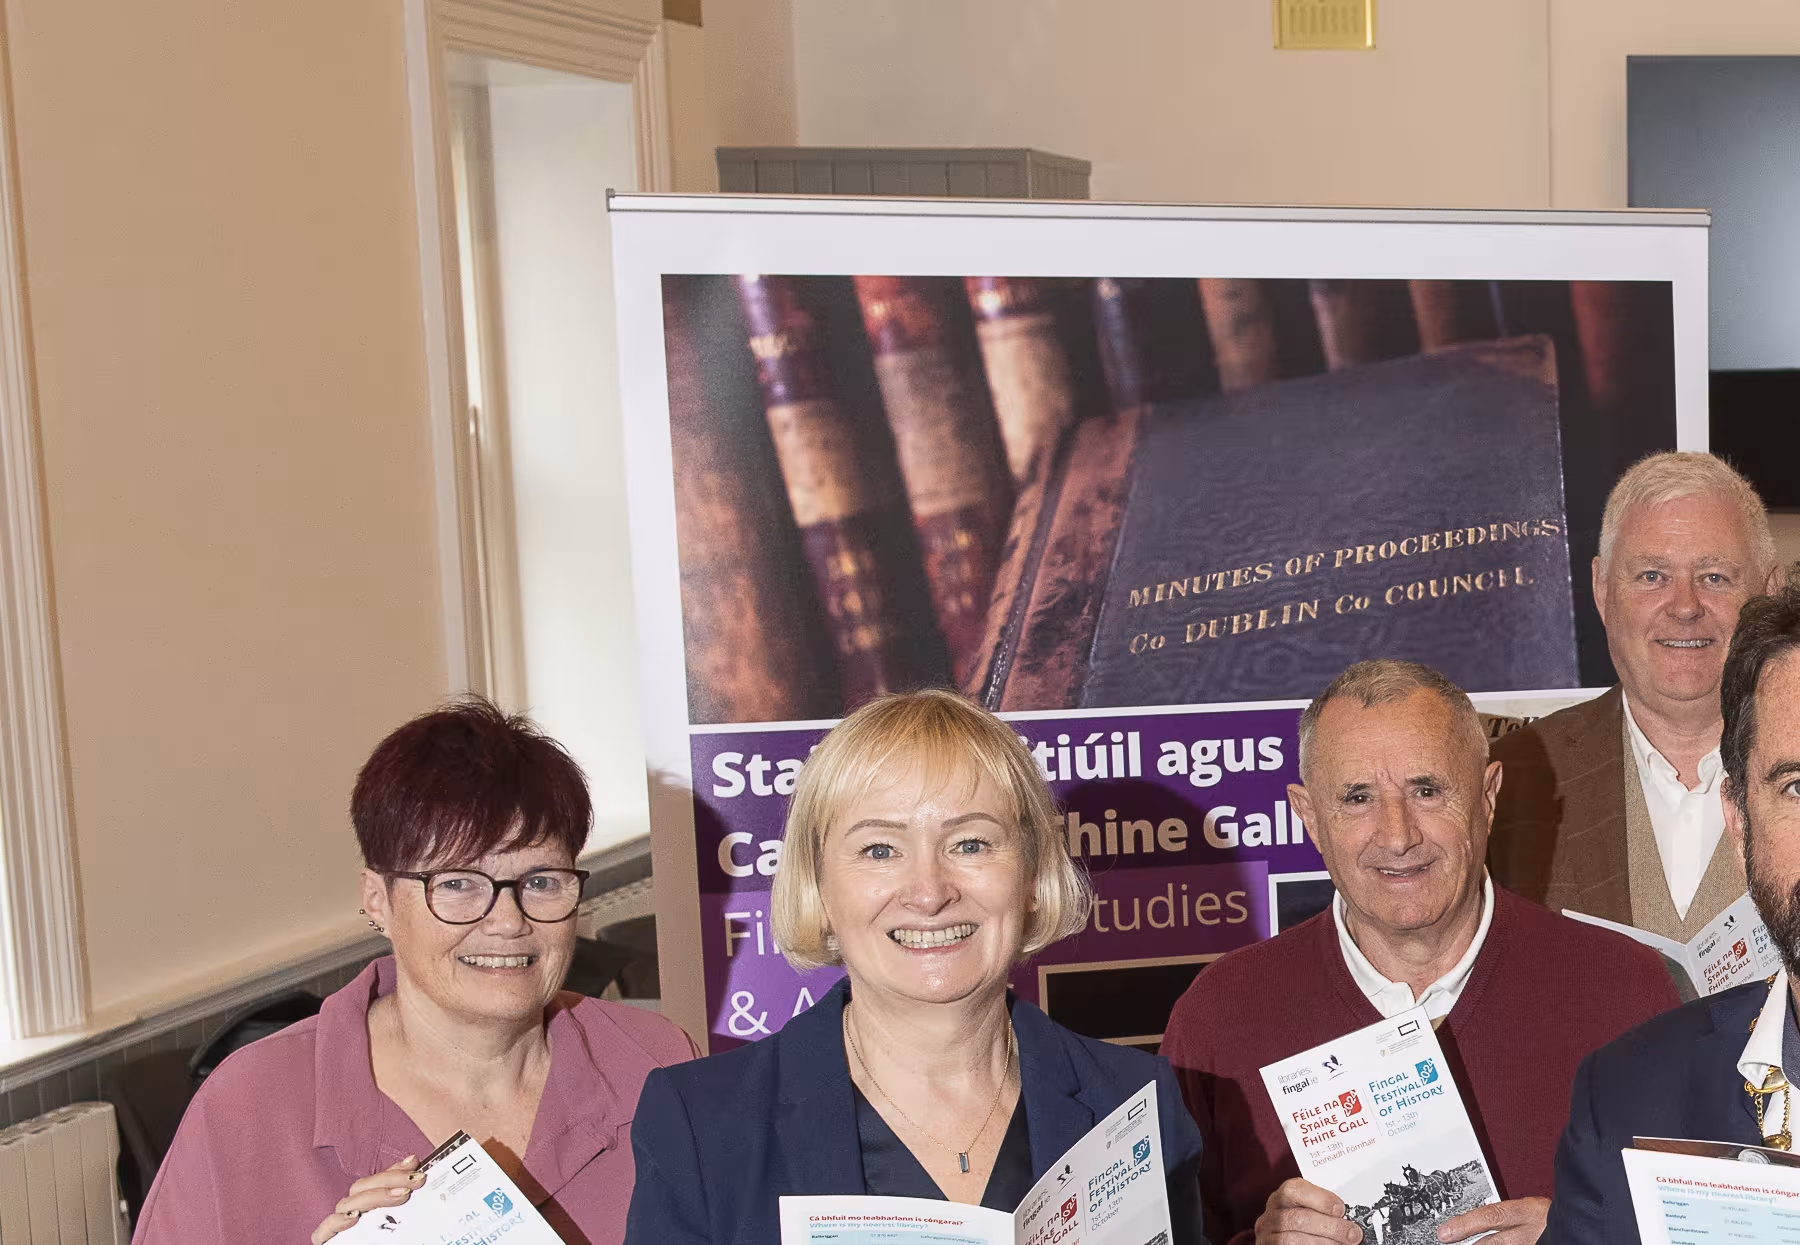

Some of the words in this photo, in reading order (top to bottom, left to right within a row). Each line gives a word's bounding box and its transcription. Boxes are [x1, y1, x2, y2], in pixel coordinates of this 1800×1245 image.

[1128, 562, 1273, 609] MINUTES
[1284, 552, 1327, 576] OF
[1333, 518, 1561, 569] PROCEEDINGS
[1129, 632, 1166, 655] Co
[1182, 600, 1319, 644] DUBLIN
[1334, 594, 1370, 614] Co
[1384, 567, 1534, 606] COUNCIL
[1157, 737, 1284, 787] agus
[1203, 800, 1304, 849] Gall
[1090, 883, 1248, 932] tudies
[1707, 962, 1731, 984] STAIRE
[1708, 974, 1730, 994] FHINE
[1731, 958, 1751, 974] GALL
[728, 990, 771, 1036] &
[1283, 1075, 1319, 1096] fingal.ie
[1368, 1072, 1409, 1093] FINGAL
[1373, 1081, 1420, 1105] FESTIVAL
[1379, 1105, 1394, 1117] OF
[1396, 1085, 1445, 1110] HISTORY
[1300, 1114, 1338, 1134] STAIRE
[1302, 1130, 1337, 1148] FHINE
[1338, 1117, 1369, 1133] GALL
[1387, 1120, 1417, 1137] October
[1312, 1148, 1345, 1167] Deireadh
[1346, 1137, 1376, 1154] Fómhair
[1088, 1158, 1125, 1191] FINGAL
[1089, 1165, 1132, 1201] FESTIVAL
[1090, 1197, 1103, 1213] OF
[1105, 1163, 1153, 1200] HISTORY
[1022, 1194, 1051, 1230] fingal.ie
[1092, 1207, 1120, 1232] October
[1052, 1220, 1080, 1243] GALL
